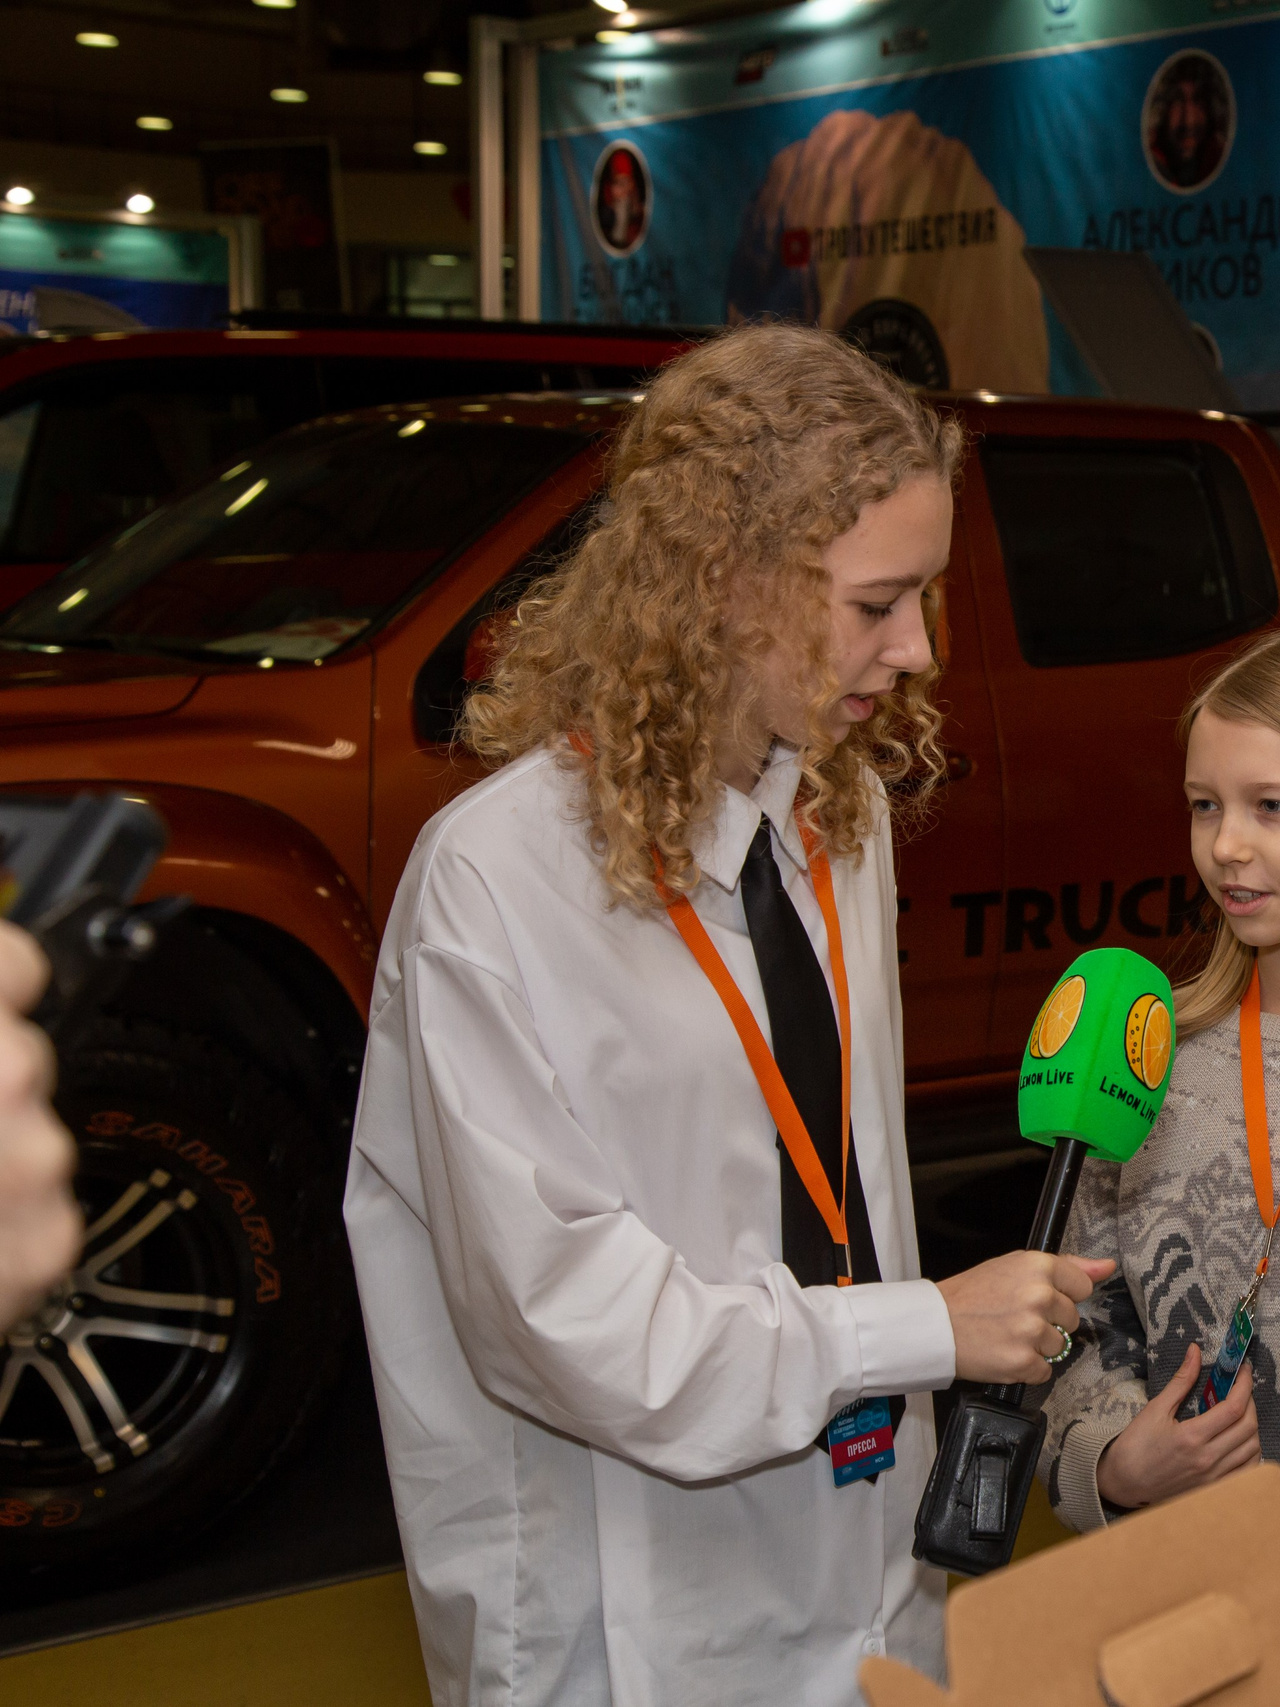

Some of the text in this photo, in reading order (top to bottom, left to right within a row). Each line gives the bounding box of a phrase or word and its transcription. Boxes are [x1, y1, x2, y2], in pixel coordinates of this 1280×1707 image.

[1164, 251, 1264, 301] ИКОВ
[951, 874, 1215, 958] TRUCK
[1099, 1075, 1142, 1111] LEMON
[85, 1109, 283, 1304] SAHARA
[847, 1437, 877, 1457] ПРЕССА
[0, 1496, 83, 1528] CS
